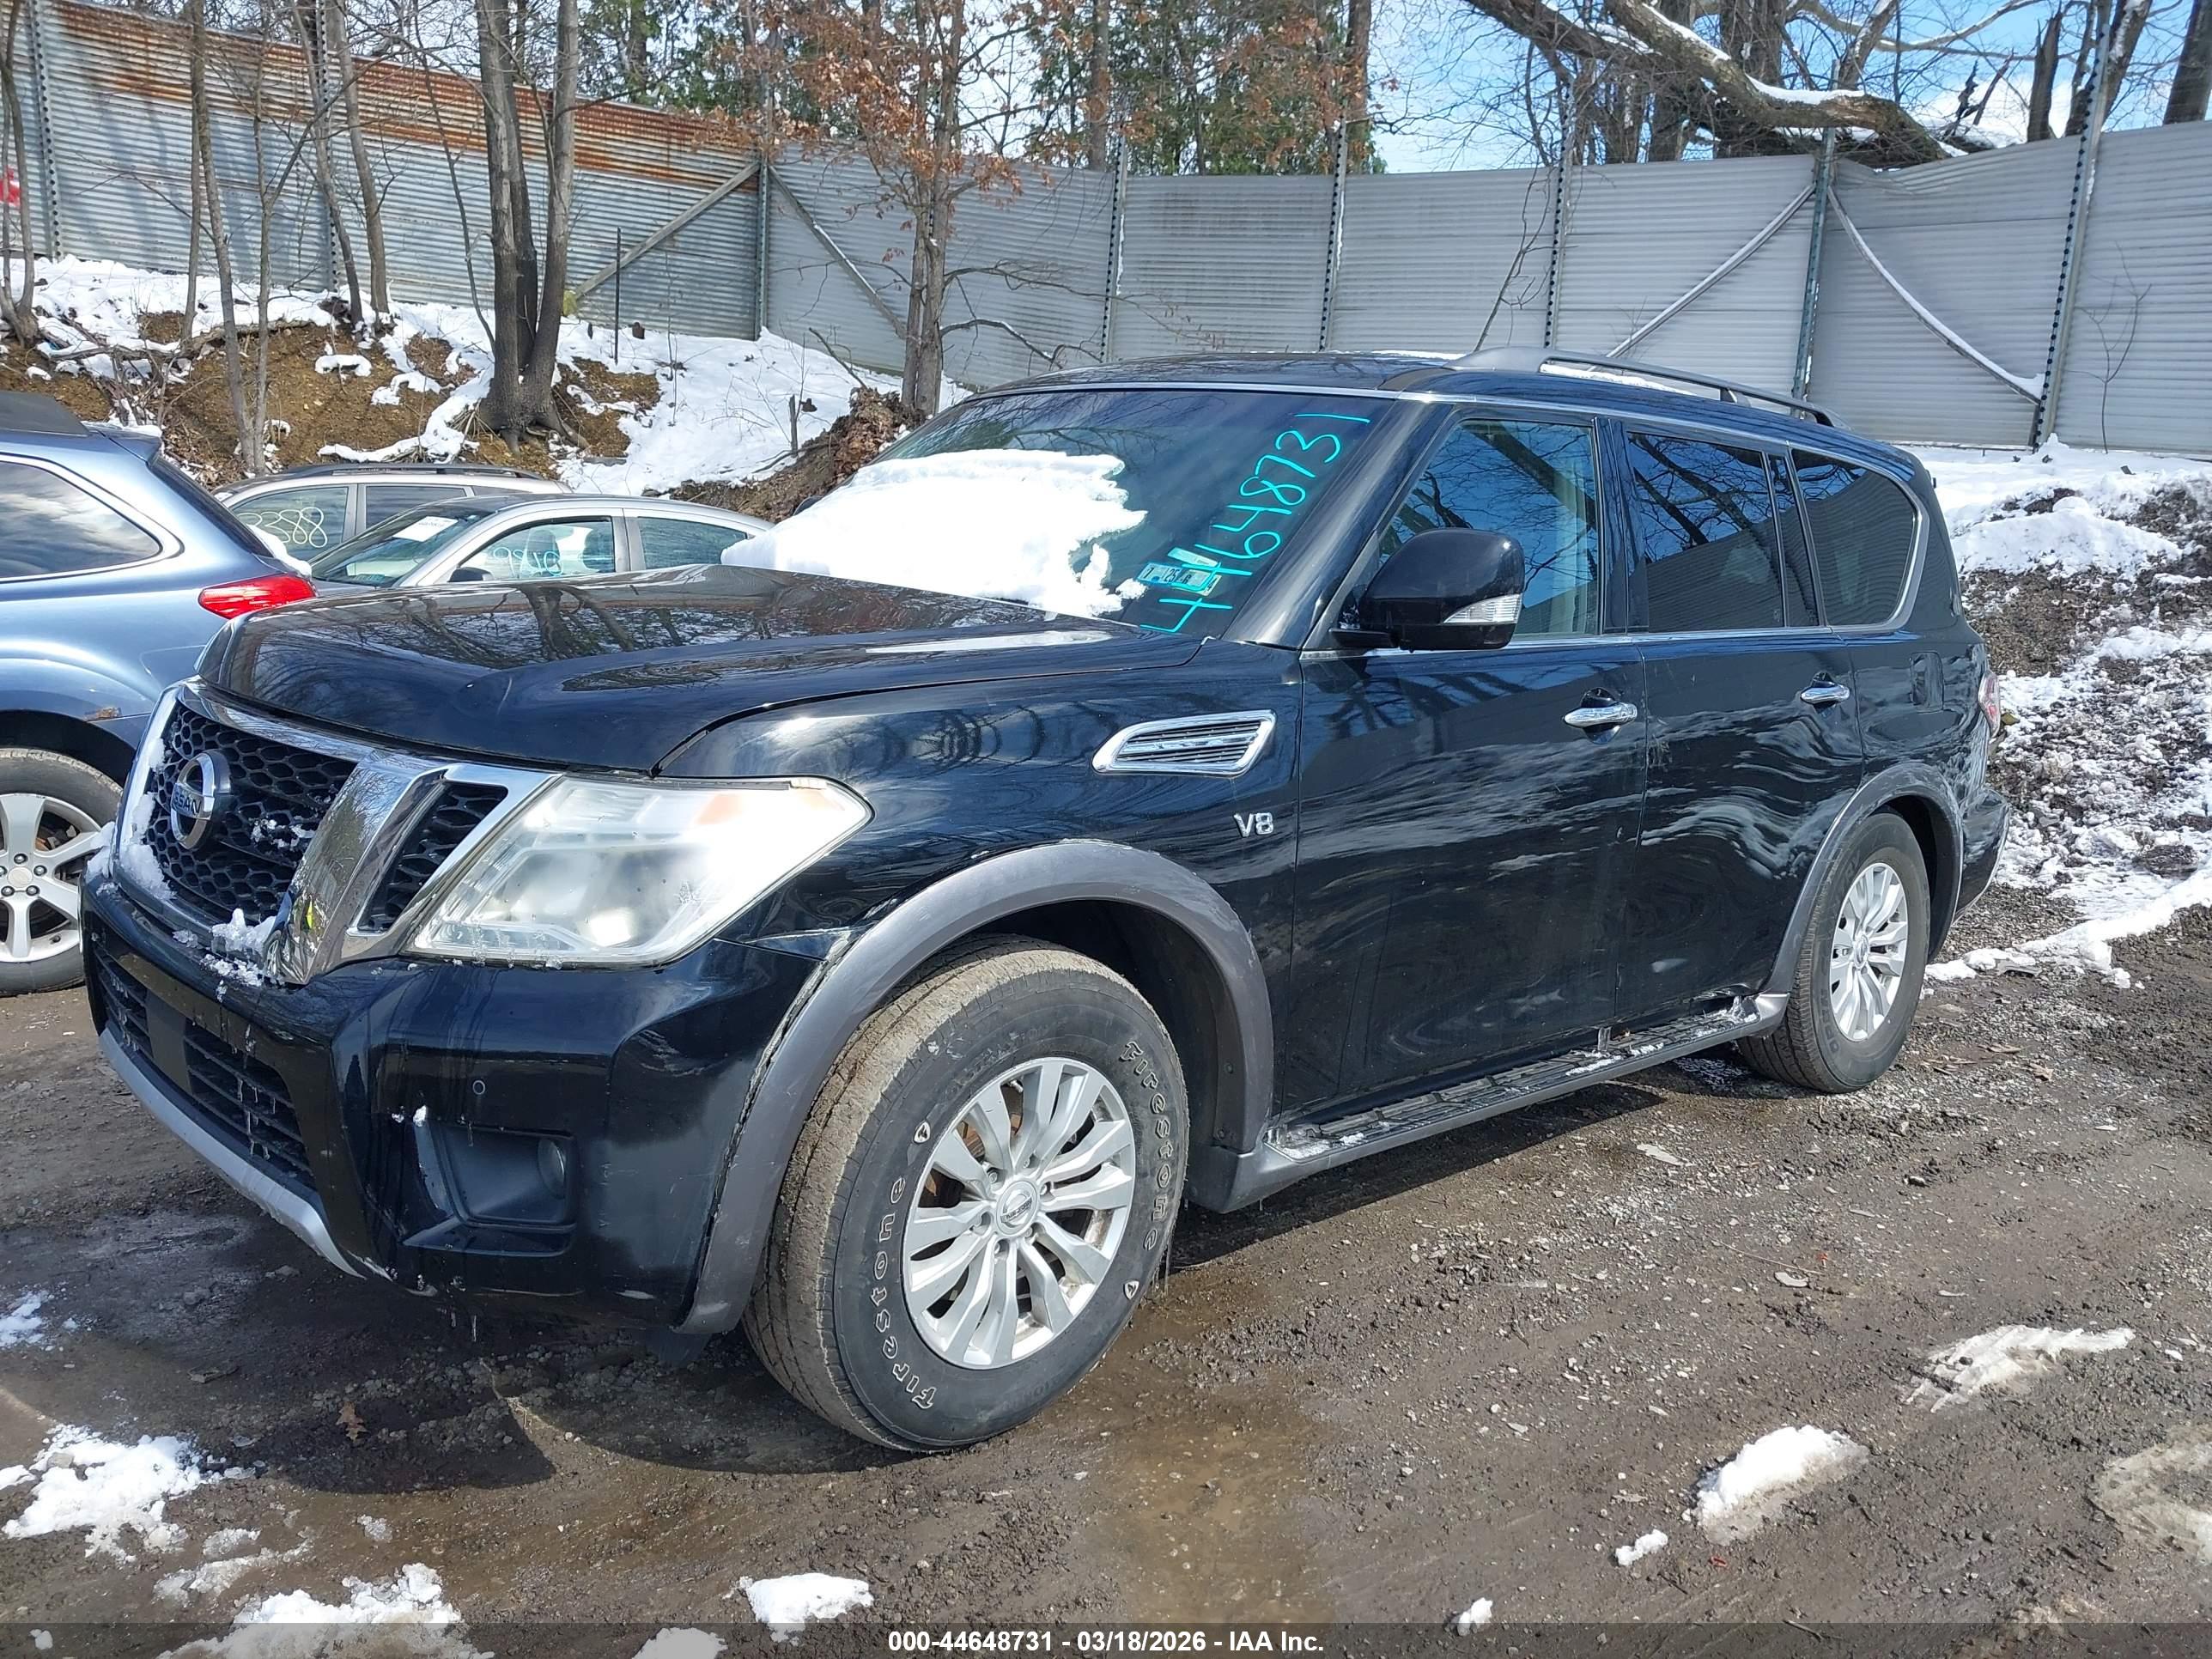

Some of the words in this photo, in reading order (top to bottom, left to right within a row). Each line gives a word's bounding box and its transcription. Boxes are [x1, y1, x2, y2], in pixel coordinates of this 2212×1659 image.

[1139, 413, 1371, 633] 44648731
[1233, 811, 1274, 837] V8
[1120, 1040, 1174, 1251] Firestone
[870, 1176, 937, 1410] Firestone
